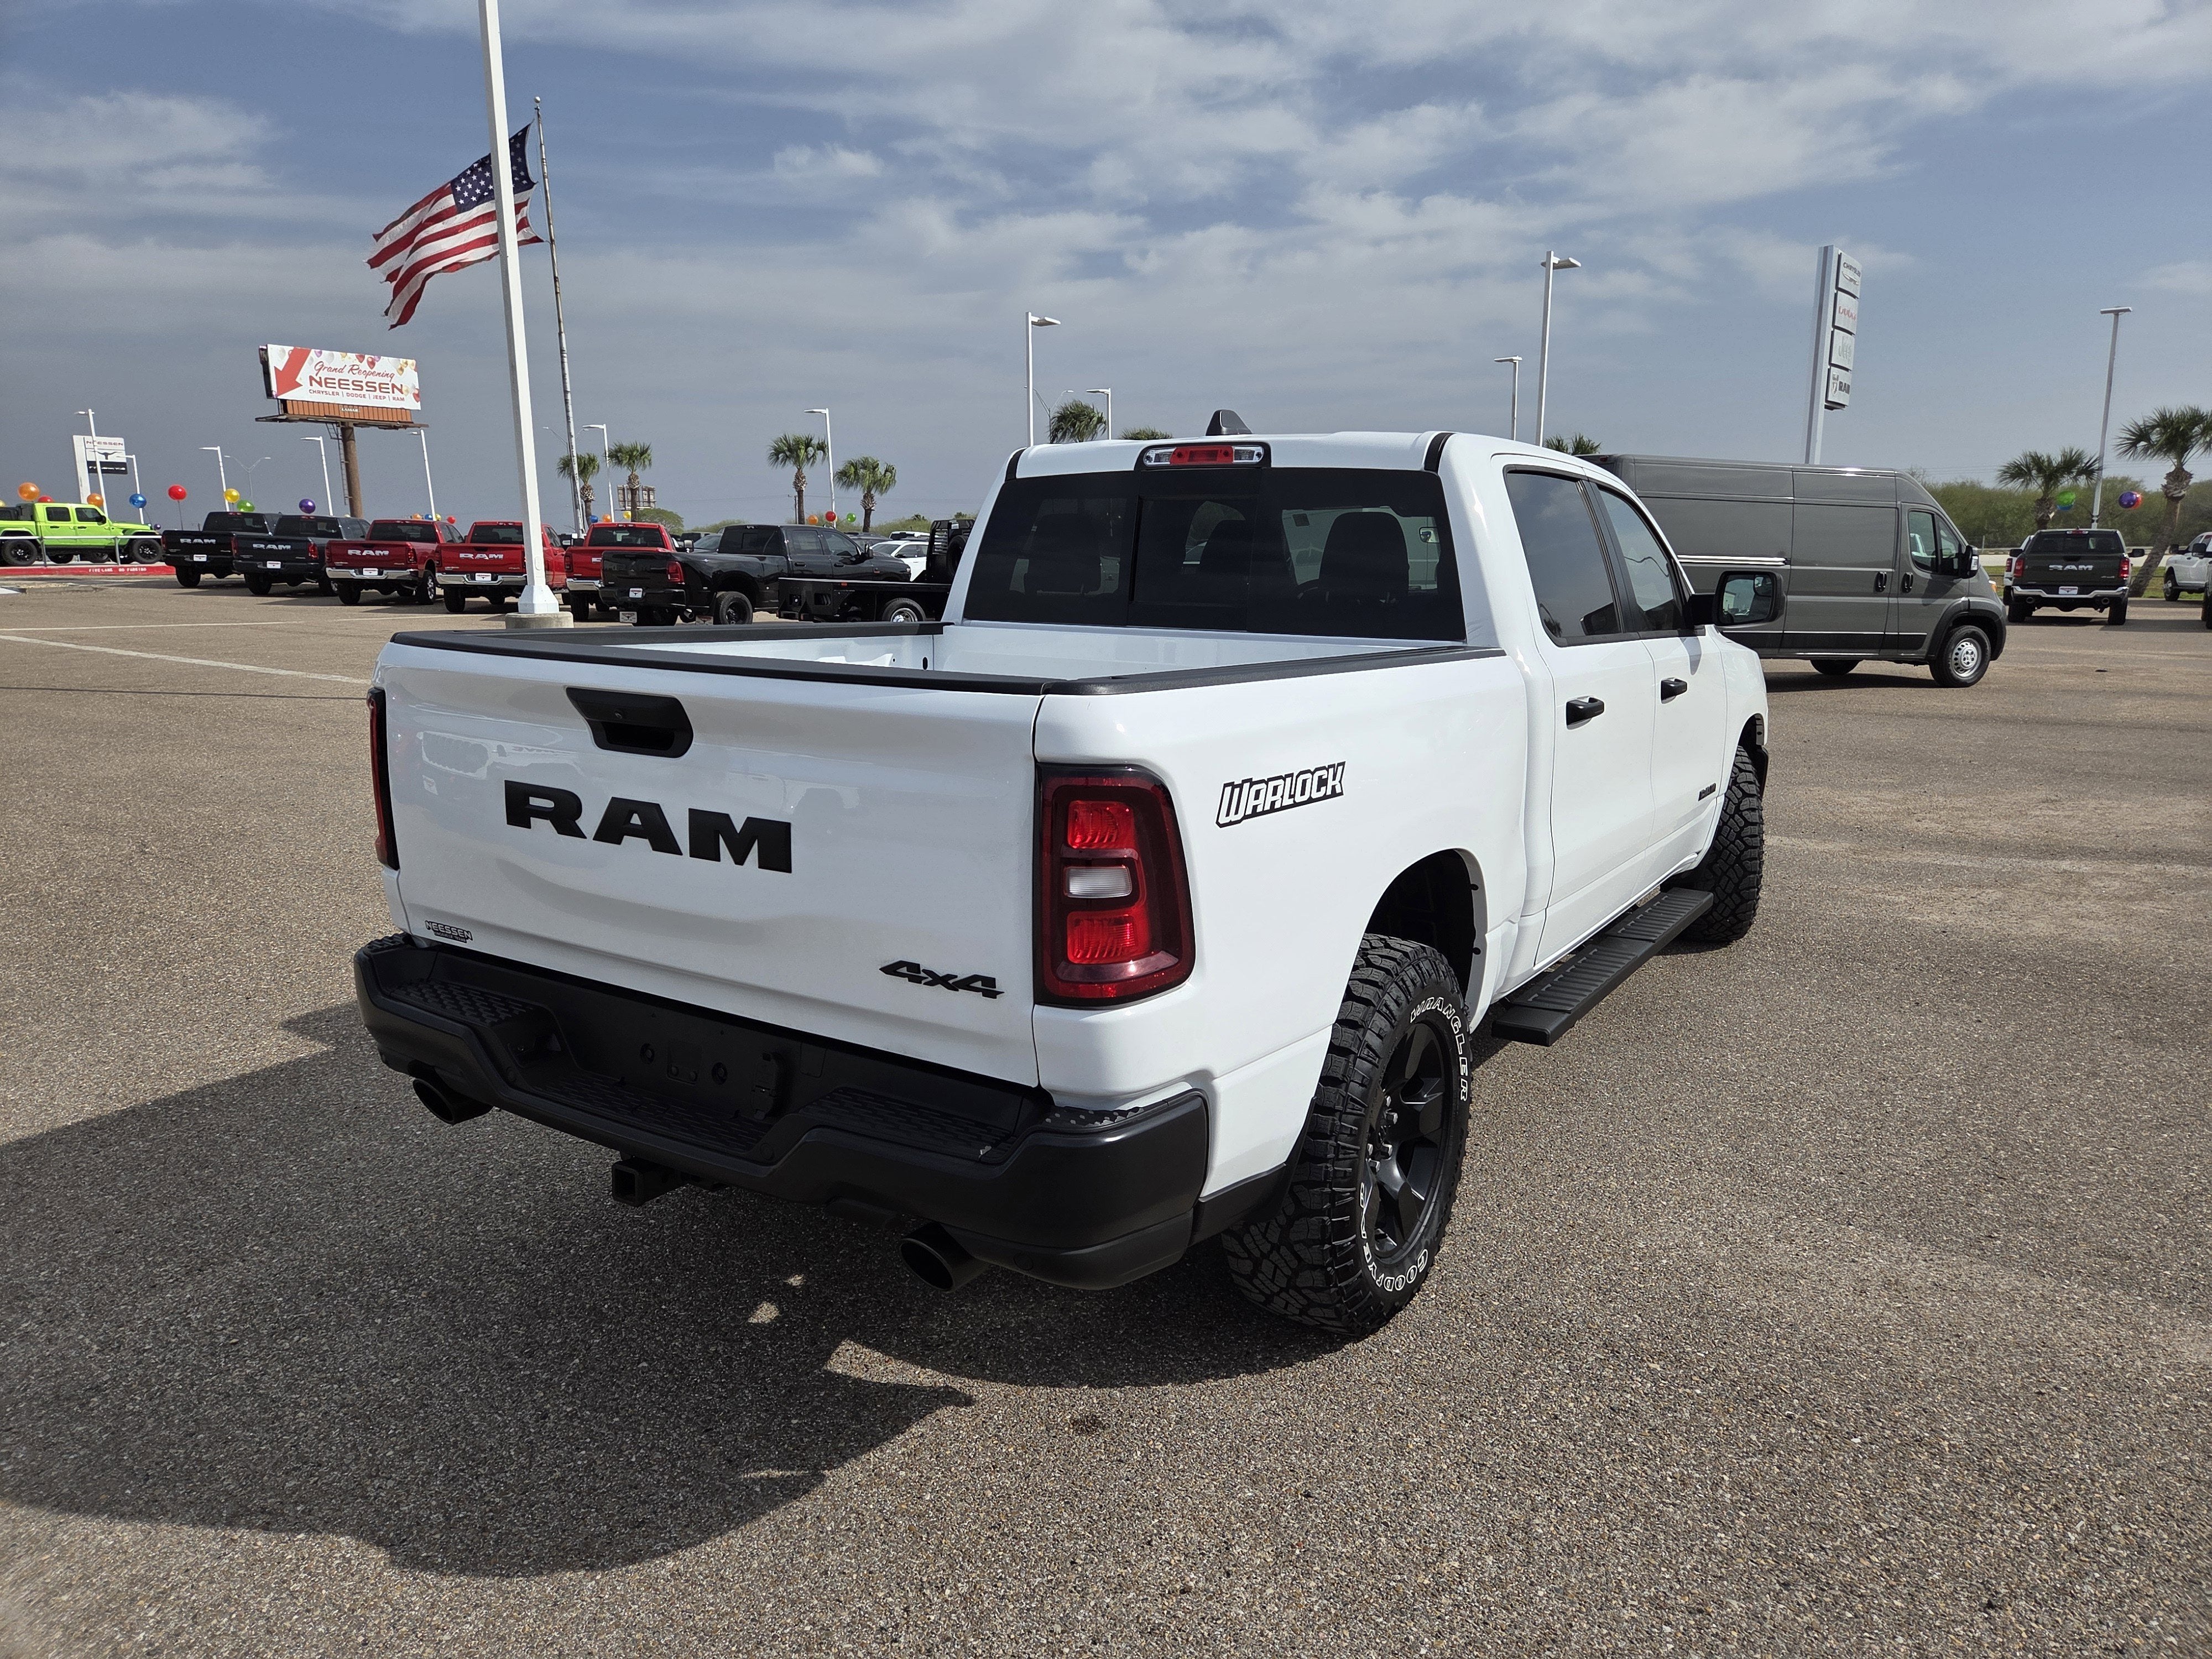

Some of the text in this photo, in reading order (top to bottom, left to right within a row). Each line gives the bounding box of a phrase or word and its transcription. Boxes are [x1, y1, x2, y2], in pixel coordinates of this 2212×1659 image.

[309, 375, 404, 394] NEESSEN
[314, 361, 395, 382] Grand Reopening
[1215, 761, 1346, 828] WARLOCK
[504, 779, 792, 874] RAM
[425, 920, 473, 941] NEESSEN
[1410, 997, 1468, 1102] WRANGLER
